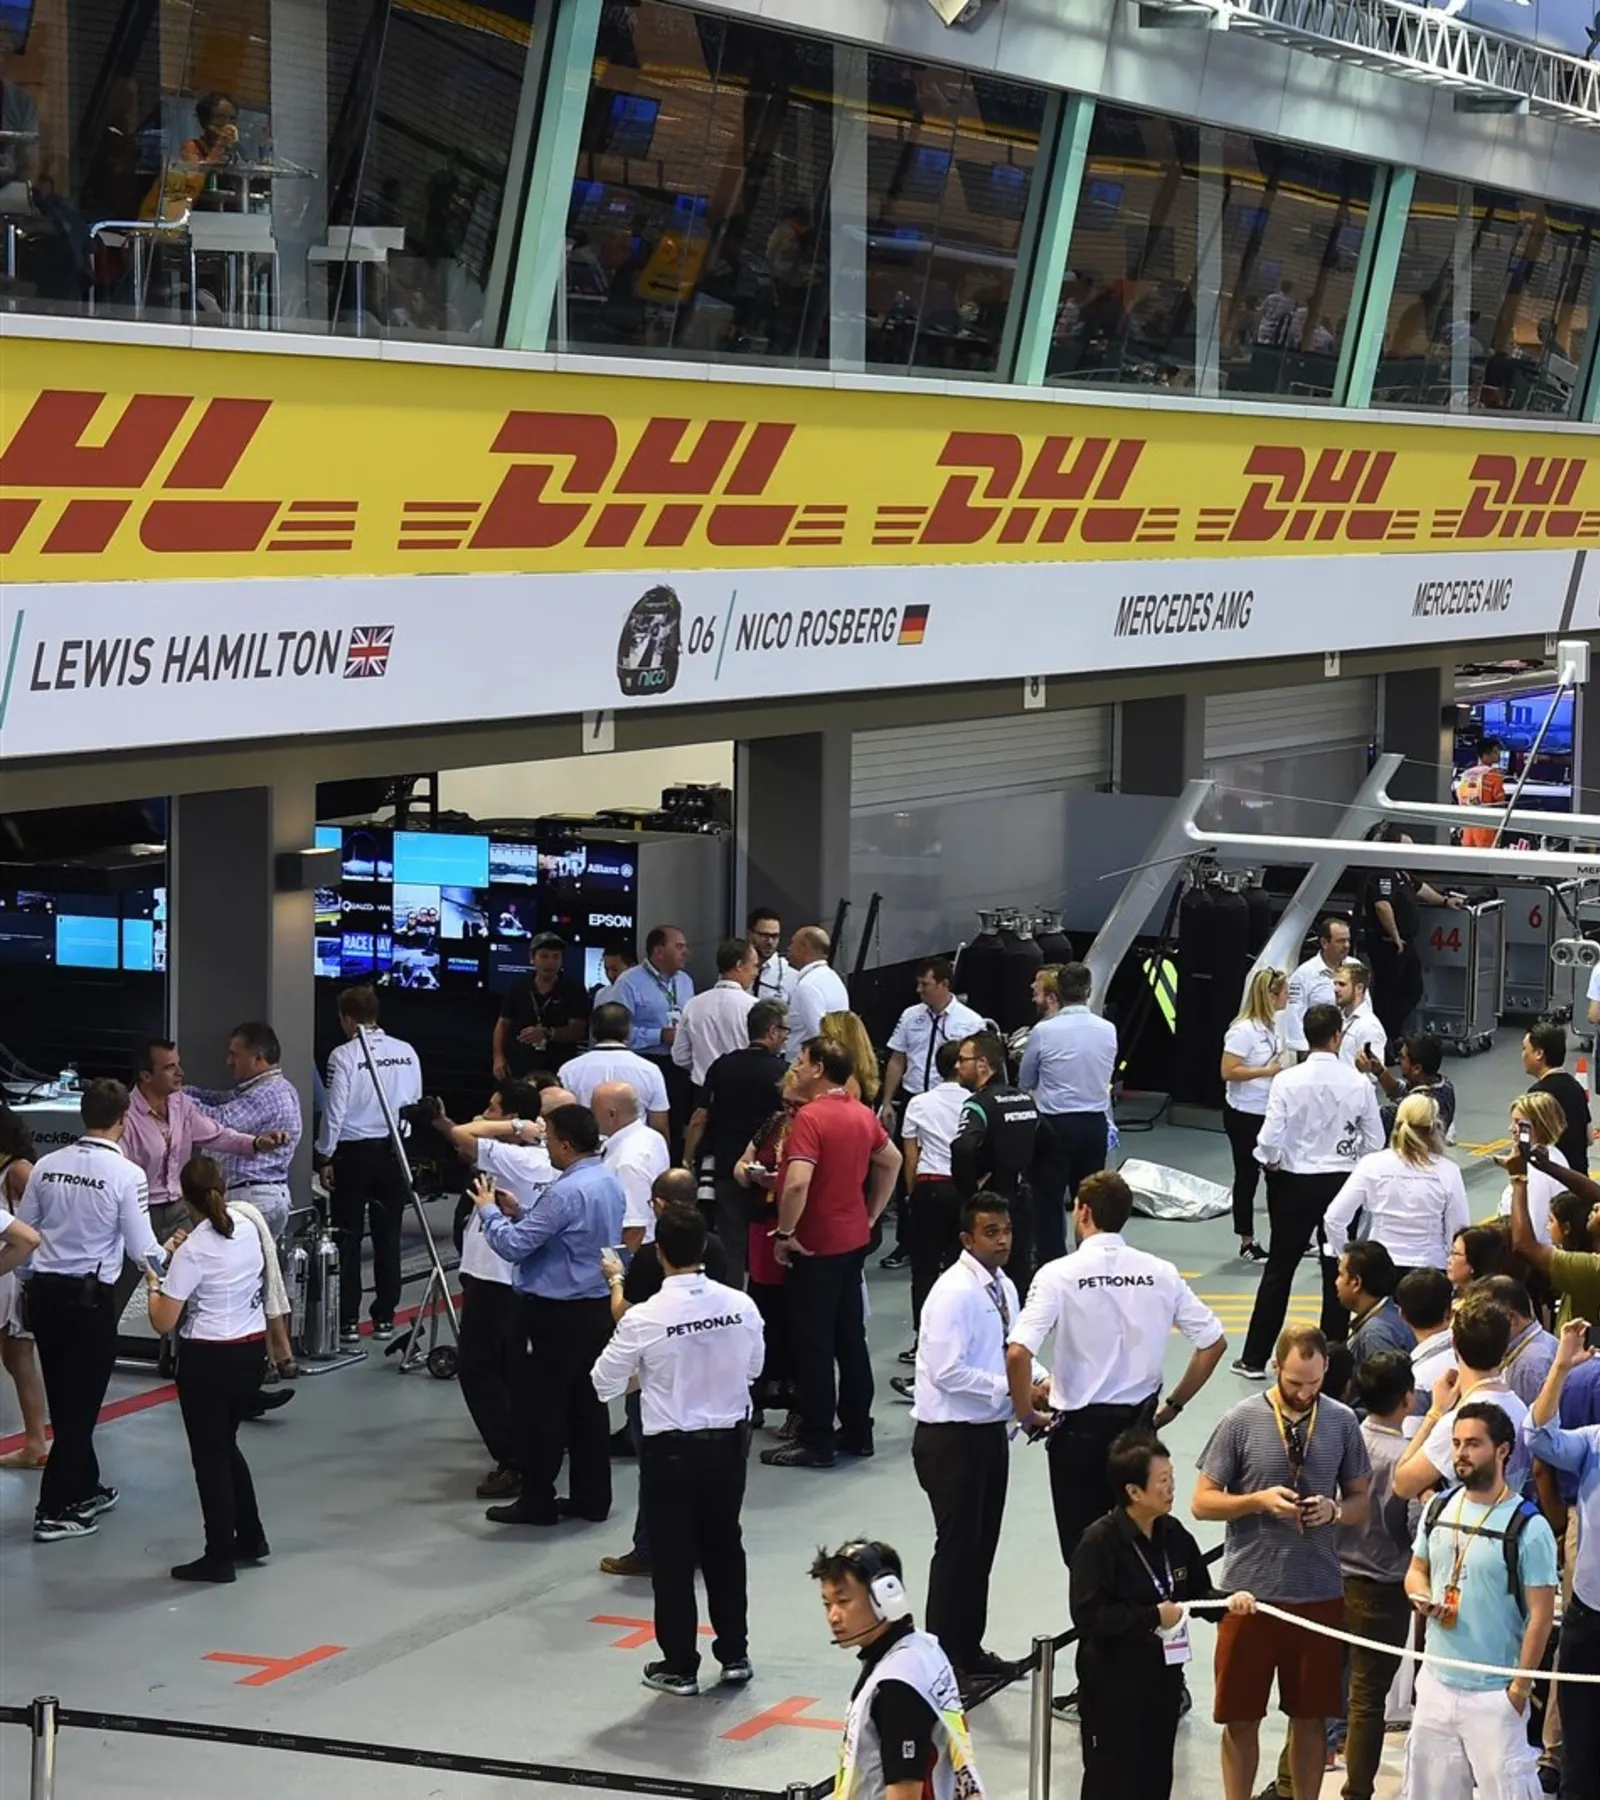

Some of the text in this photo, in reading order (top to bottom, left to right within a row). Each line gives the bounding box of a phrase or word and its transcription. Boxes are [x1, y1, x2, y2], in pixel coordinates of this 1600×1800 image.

[467, 411, 797, 548] DHL
[919, 431, 1146, 545] DHL
[1228, 445, 1396, 541] DHL
[1455, 454, 1587, 538] DHL
[1114, 590, 1254, 638] MERCEDES AMG
[1412, 578, 1513, 617] MERCEDES AMG
[688, 604, 899, 654] 06 NICO ROSBERG
[30, 629, 344, 692] LEWIS HAMILTON
[587, 863, 620, 875] Allianz
[588, 913, 632, 928] EPSON
[1528, 905, 1543, 928] 6
[343, 935, 368, 950] RACE
[1430, 926, 1462, 953] 44
[41, 1172, 105, 1189] PETRONAS
[1078, 1275, 1154, 1290] PETRONAS
[666, 1313, 743, 1337] PETRONAS
